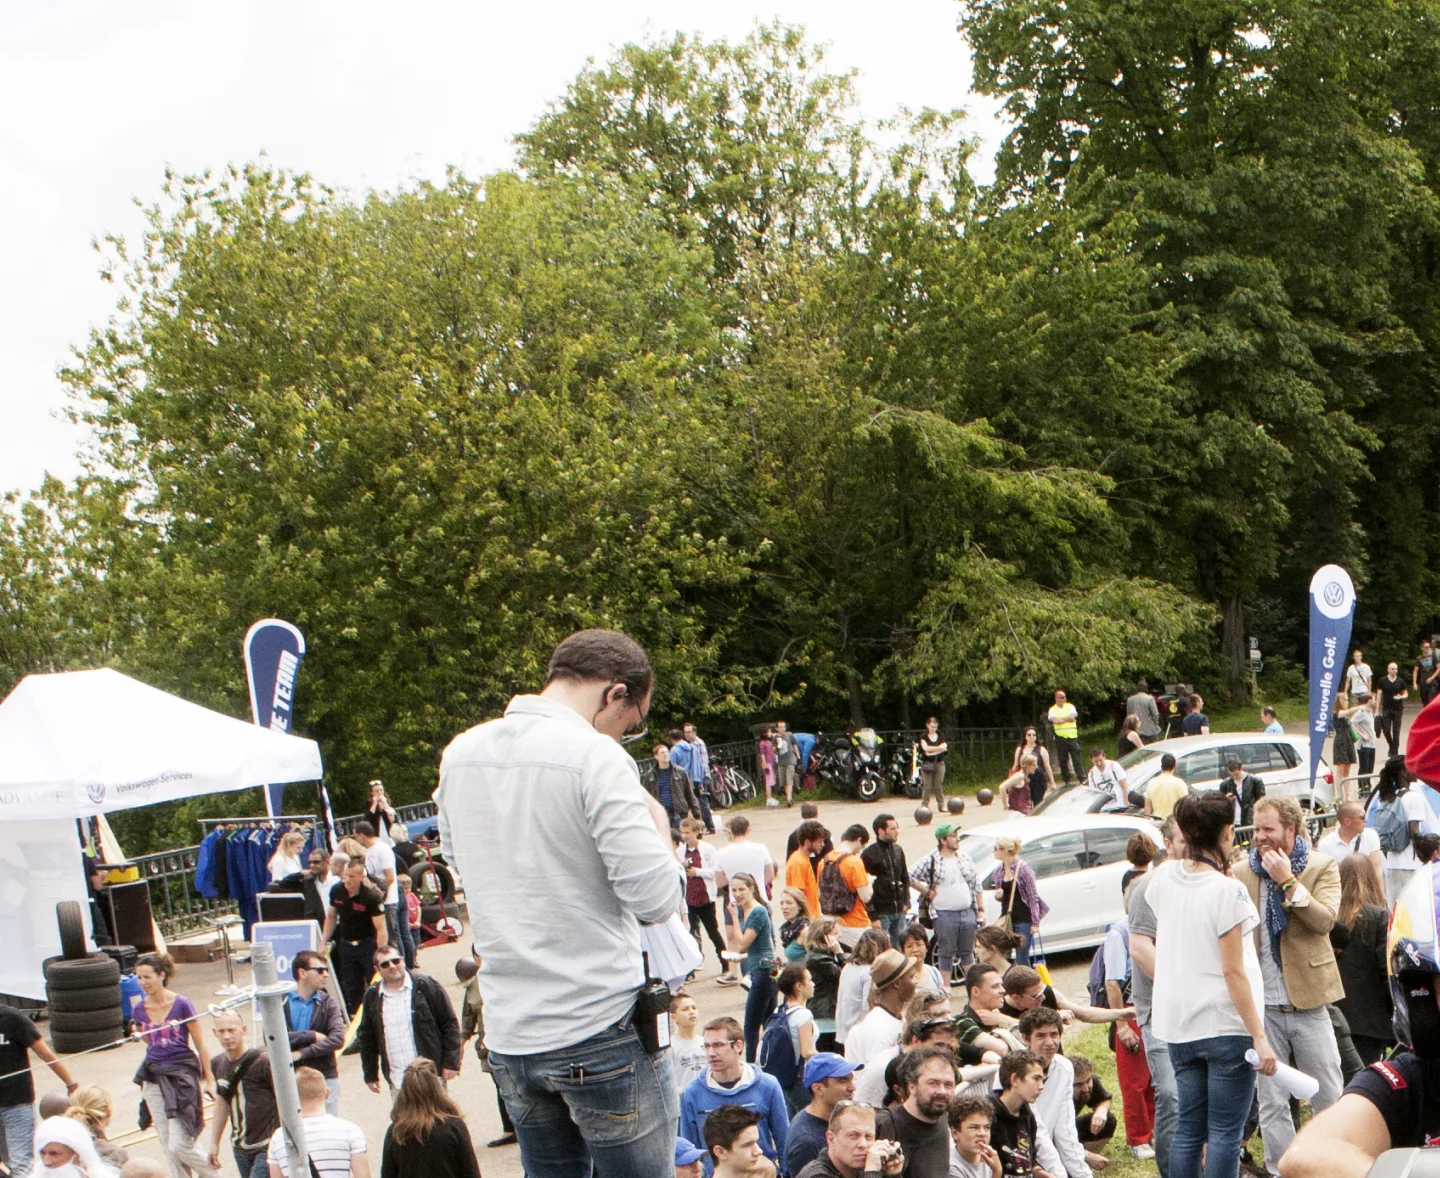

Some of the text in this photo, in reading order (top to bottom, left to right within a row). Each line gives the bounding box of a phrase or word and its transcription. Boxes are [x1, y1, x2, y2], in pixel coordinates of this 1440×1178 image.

[271, 649, 299, 714] TEAM
[1315, 636, 1337, 733] Nouvelle Golf.
[115, 771, 193, 794] Volkswagen Services
[1374, 1060, 1399, 1087] OTAL
